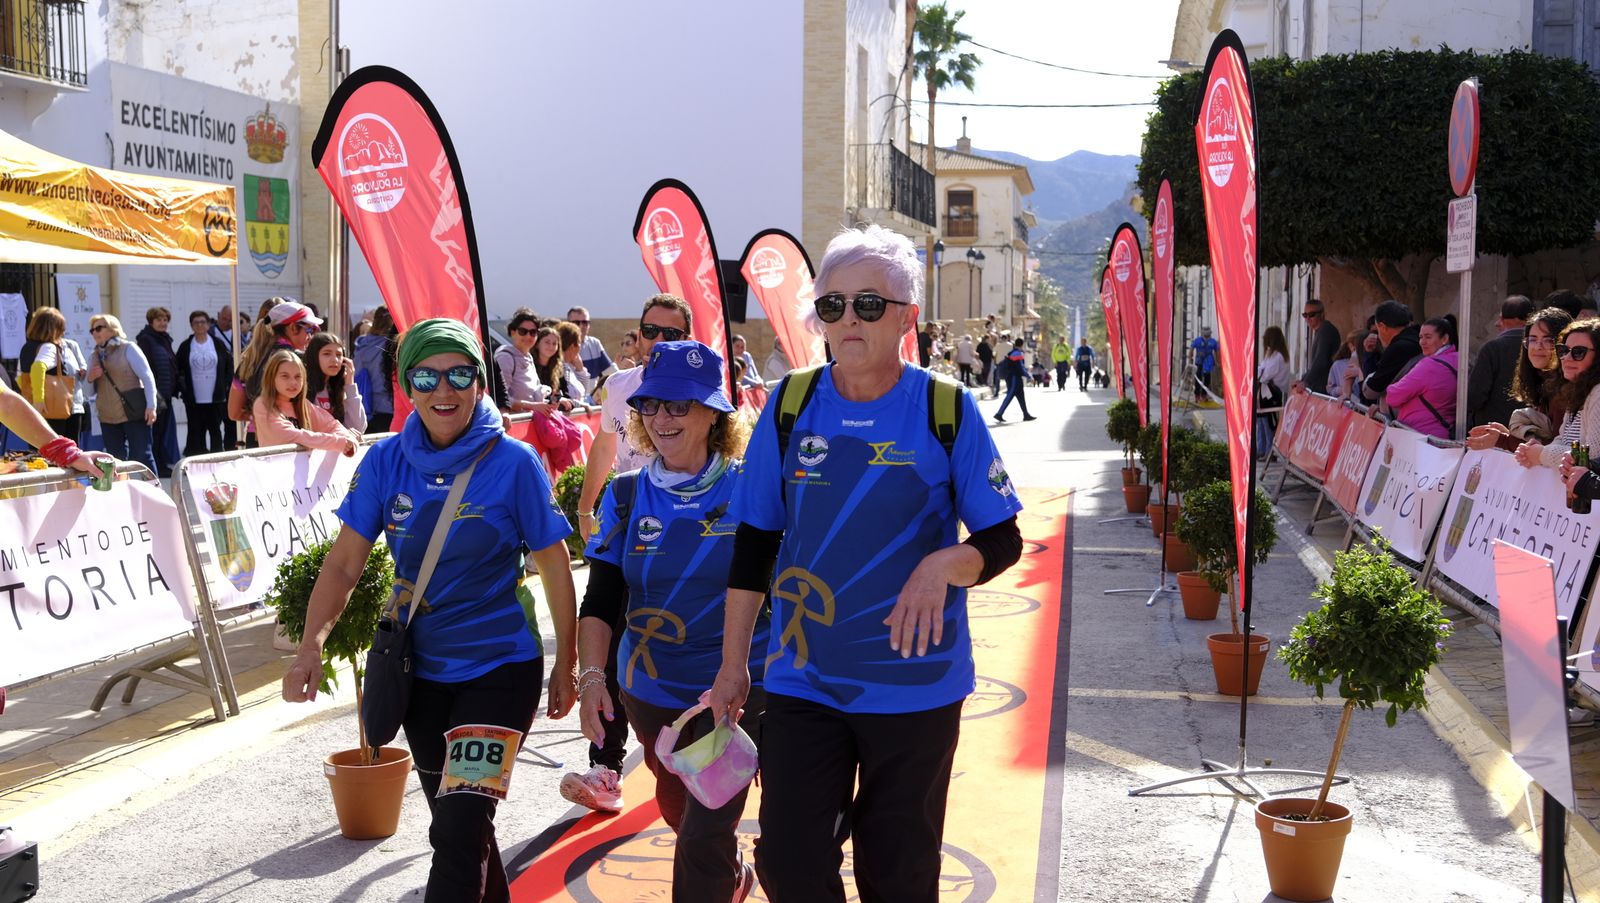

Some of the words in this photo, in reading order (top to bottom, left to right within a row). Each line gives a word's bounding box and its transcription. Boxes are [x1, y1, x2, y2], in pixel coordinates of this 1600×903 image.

[120, 100, 236, 145] EXCELENTÍSIMO
[124, 141, 234, 180] AYUNTAMIENTO
[254, 481, 351, 512] AYUNTAMI
[121, 520, 152, 547] DE
[1483, 487, 1570, 538] AYUNTAMIENTO
[1571, 521, 1592, 548] DE
[449, 740, 505, 766] 408
